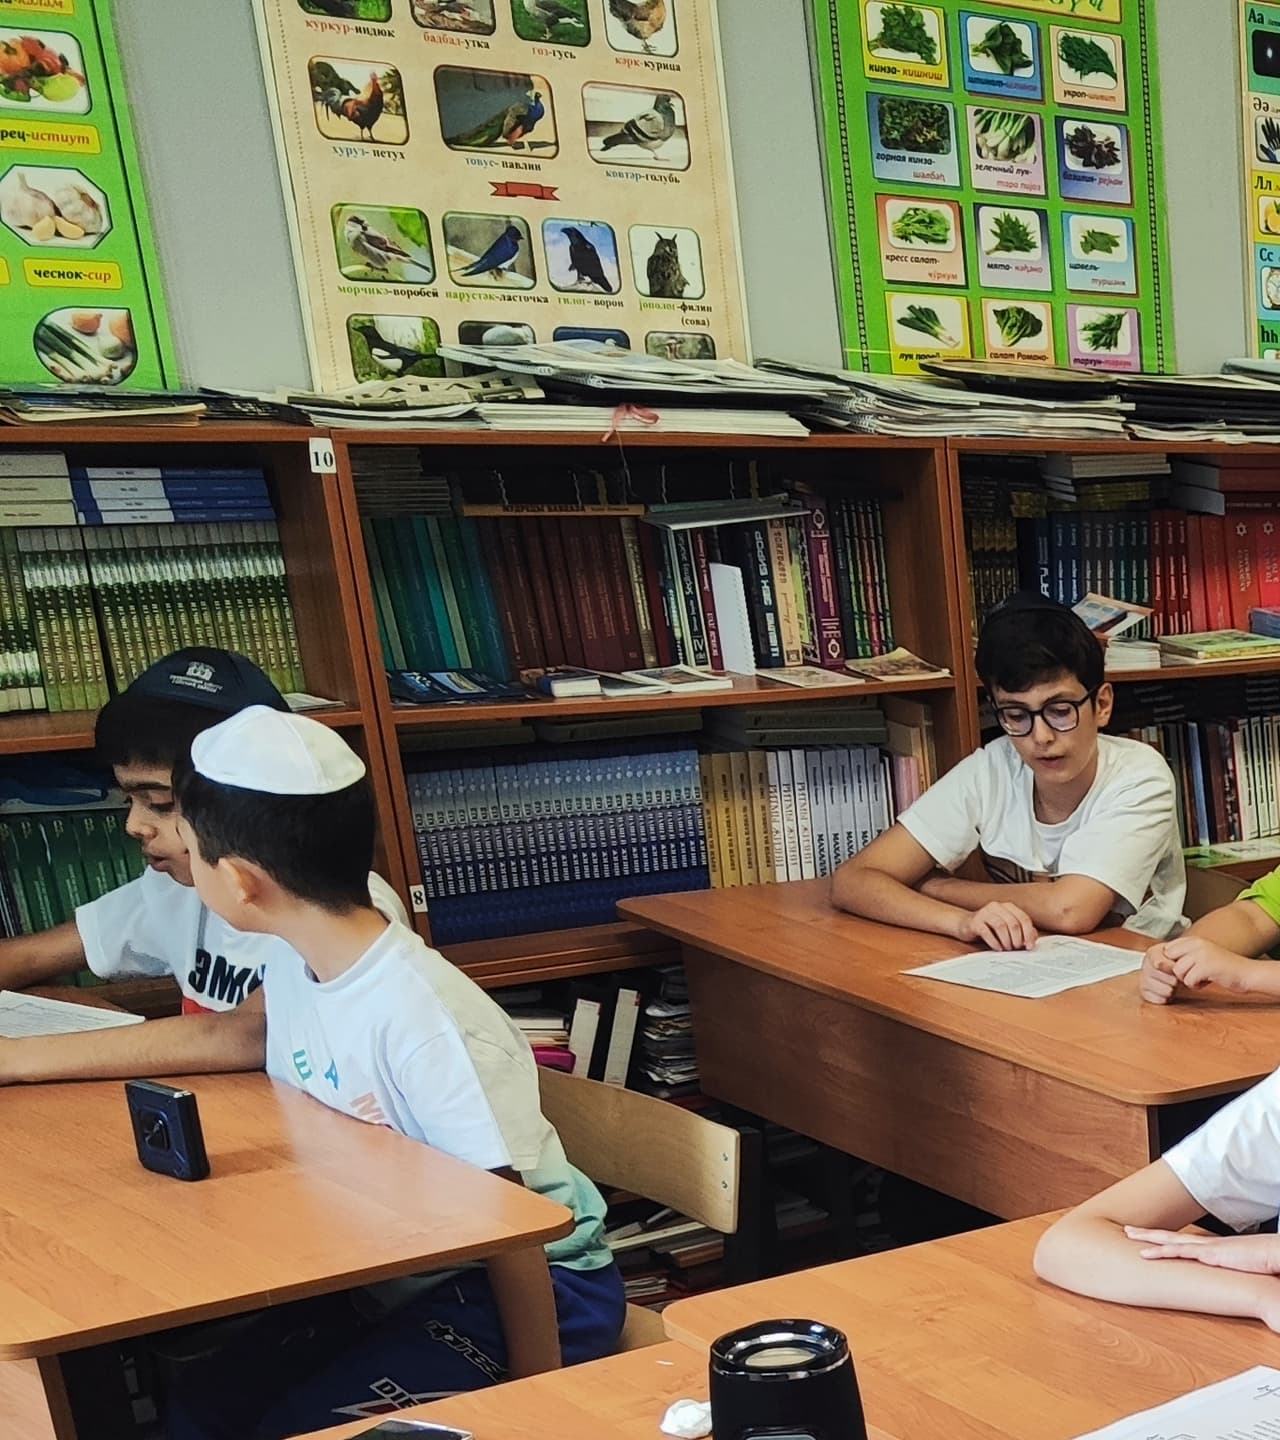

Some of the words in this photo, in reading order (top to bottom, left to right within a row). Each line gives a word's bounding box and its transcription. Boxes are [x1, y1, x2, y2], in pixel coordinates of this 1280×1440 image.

[1248, 11, 1264, 24] Аа
[372, 148, 405, 161] петух
[876, 153, 906, 163] горная
[502, 160, 542, 172] павлин
[1254, 176, 1272, 190] Лл
[886, 254, 909, 263] кресс
[1259, 248, 1273, 262] Сс
[33, 267, 112, 282] чеснок-сир
[594, 299, 623, 309] ворон
[681, 316, 710, 328] (сова)
[313, 451, 334, 468] 10
[412, 890, 423, 905] 8
